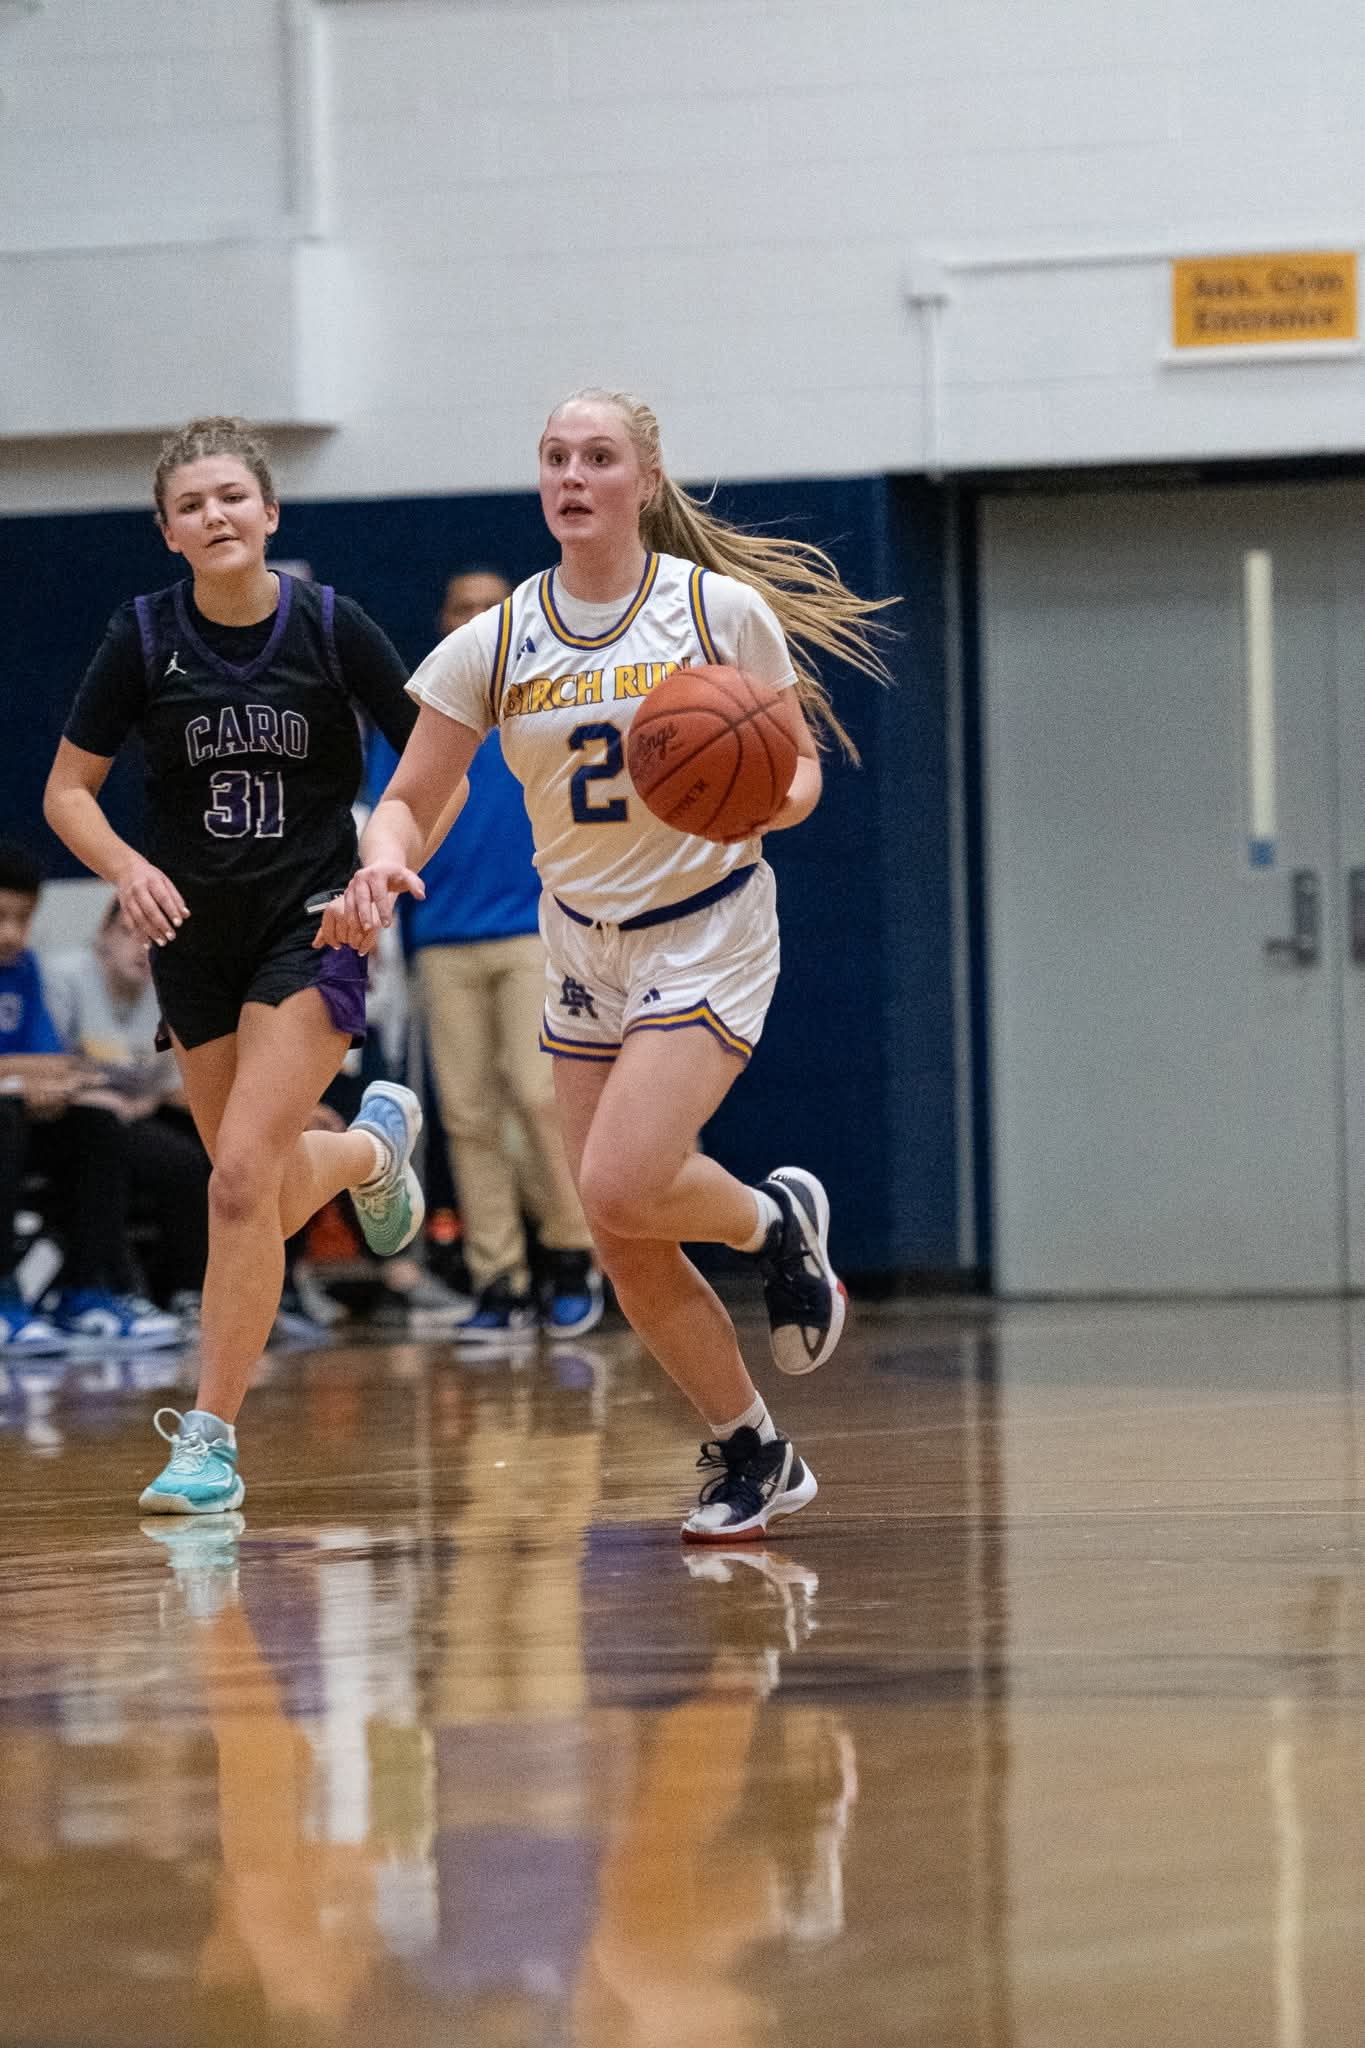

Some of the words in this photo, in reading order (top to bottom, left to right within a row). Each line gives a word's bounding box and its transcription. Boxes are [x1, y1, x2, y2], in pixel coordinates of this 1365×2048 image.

[503, 668, 604, 720] BIRCH
[185, 704, 308, 766] CARO
[204, 770, 285, 838] 31
[569, 720, 629, 824] 2
